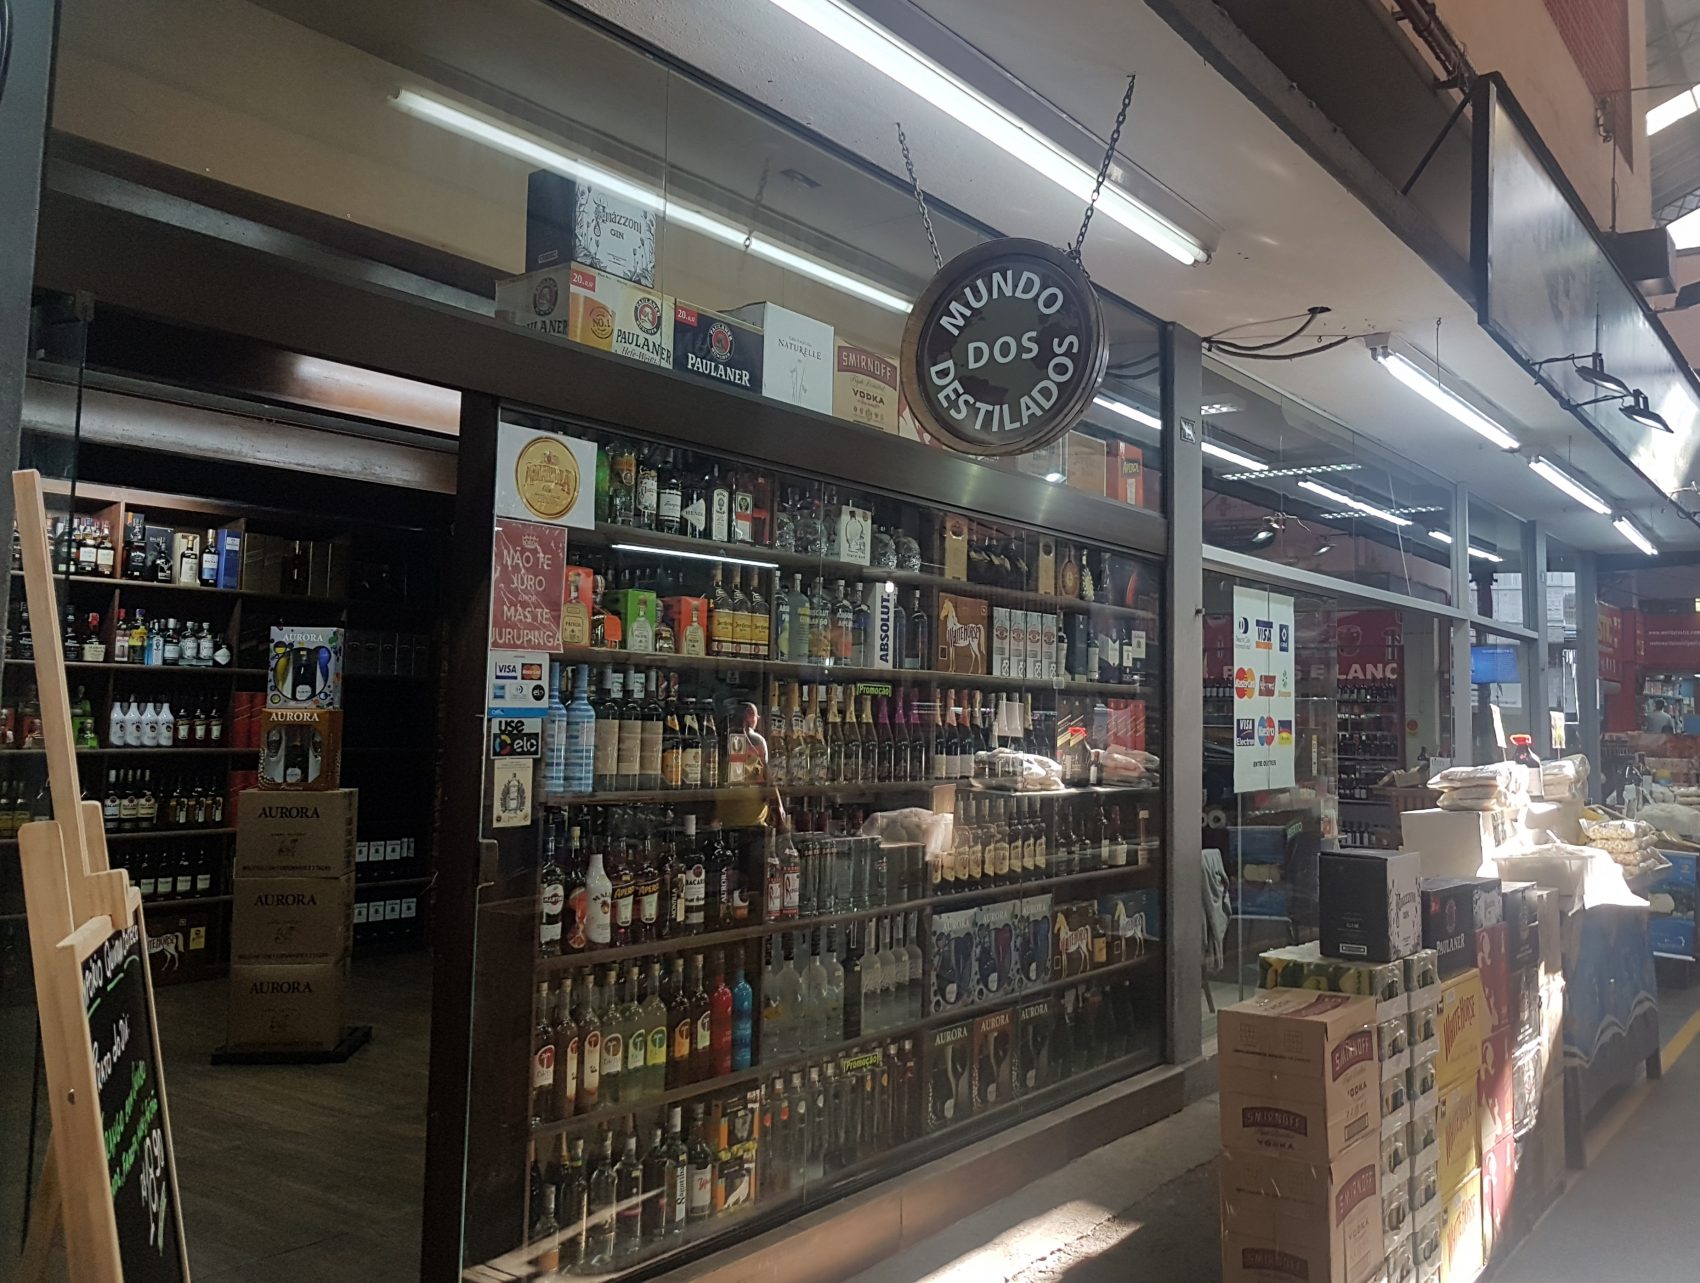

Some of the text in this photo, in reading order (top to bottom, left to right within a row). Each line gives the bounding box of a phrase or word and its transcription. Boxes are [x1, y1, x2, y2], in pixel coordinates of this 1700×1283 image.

[610, 228, 624, 240] GIN
[939, 269, 1064, 337] MUNDO
[615, 327, 672, 365] PAULANER
[778, 338, 822, 361] NATURELLE
[967, 331, 1039, 369] DOS
[687, 352, 751, 387] PAULANER
[842, 351, 892, 380] SMIRNOFF
[929, 334, 1079, 432] DESTILADOS
[852, 388, 885, 406] VODKA
[503, 547, 552, 570] NÃO TE
[510, 574, 546, 592] JURO
[535, 609, 550, 625] TE
[283, 633, 323, 642] AURORA
[490, 626, 561, 647] JURUPINGA
[879, 595, 891, 664] ABSOLUT
[1257, 628, 1272, 642] VISA
[498, 664, 517, 674] VISA
[270, 711, 320, 722] AURORA
[498, 719, 525, 733] use
[1239, 719, 1253, 730] VISA
[257, 806, 321, 819] AURORA
[720, 866, 728, 904] AURORA
[254, 893, 317, 906] AURORA
[1436, 932, 1465, 955] PAULANER
[249, 980, 313, 994] AURORA
[1021, 1003, 1048, 1020] AURORA
[980, 1013, 1010, 1033] AURORA
[934, 1026, 968, 1046] AURORA
[1334, 1037, 1369, 1071] SMIRNOFF
[1246, 1110, 1300, 1128] SMIRNOFF
[1257, 1138, 1295, 1150] VODKA
[1338, 1171, 1373, 1214] SMIRNOFF
